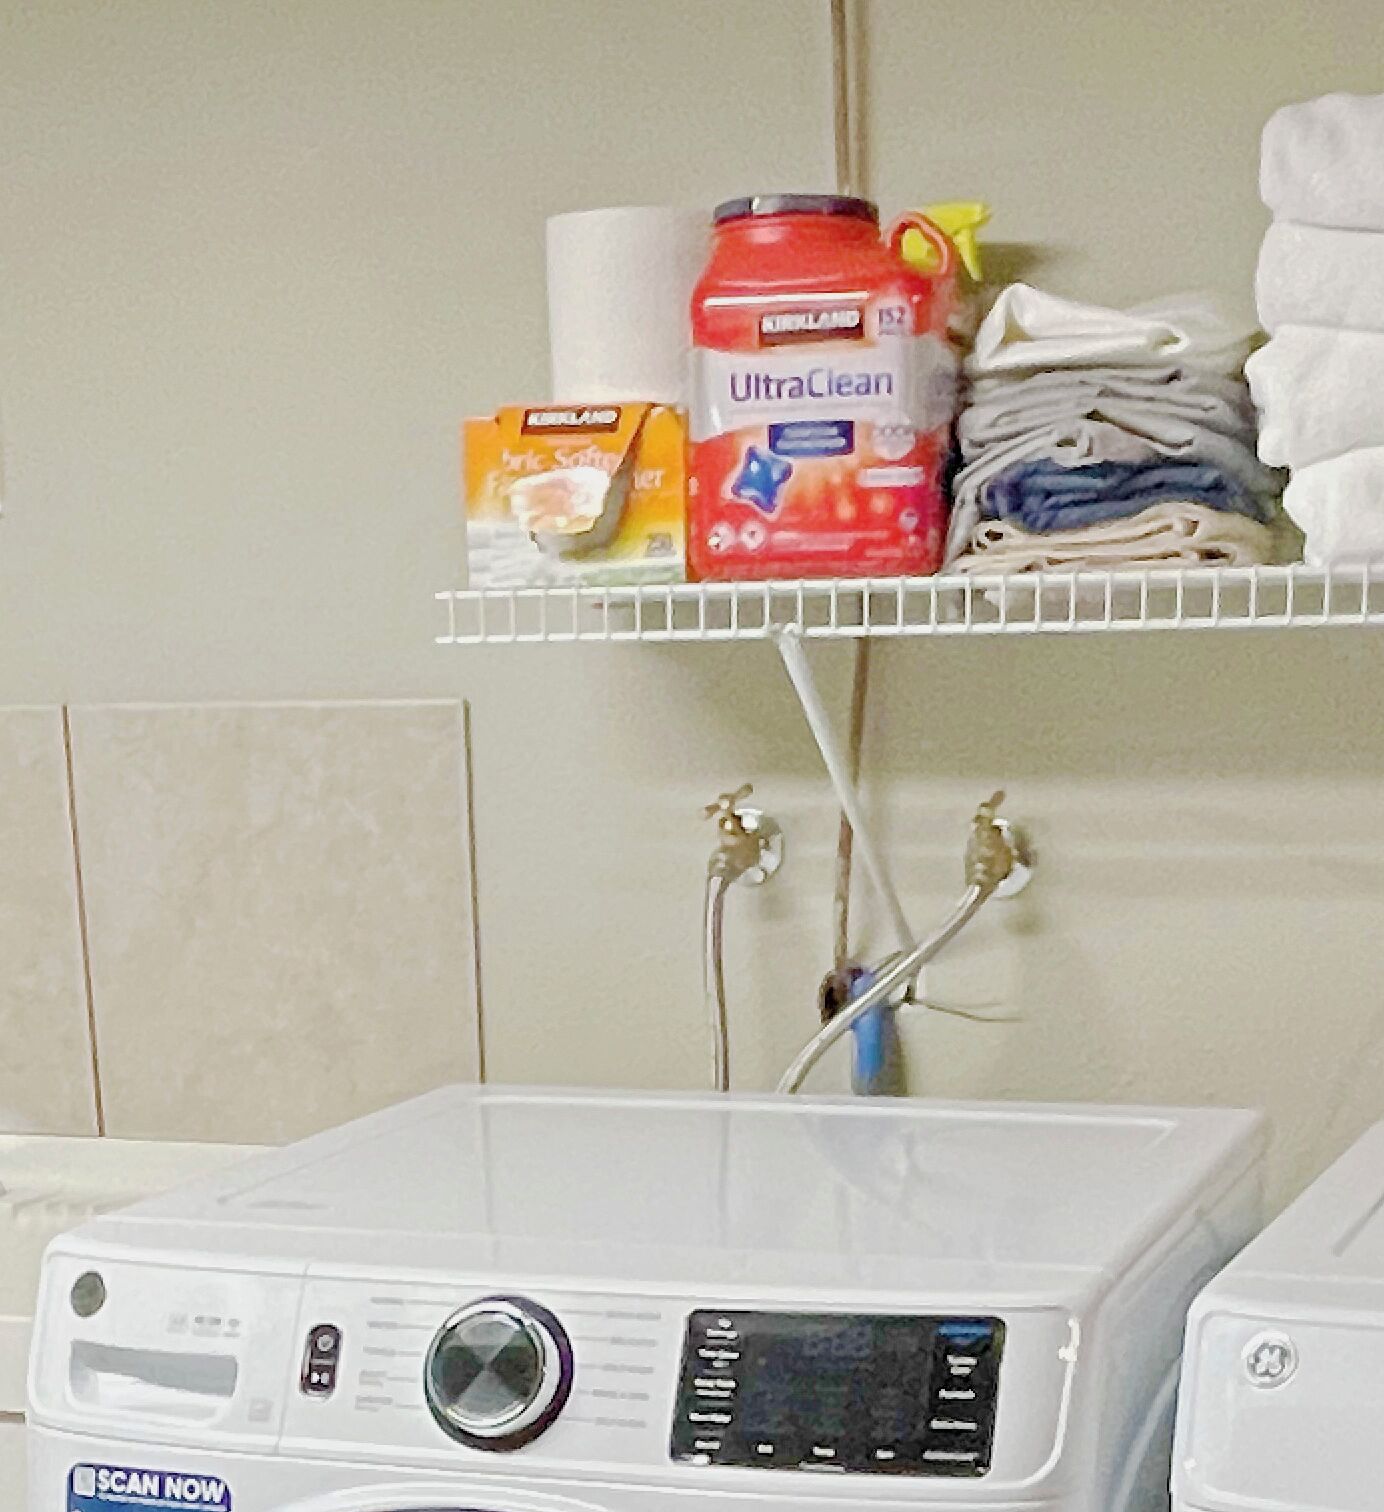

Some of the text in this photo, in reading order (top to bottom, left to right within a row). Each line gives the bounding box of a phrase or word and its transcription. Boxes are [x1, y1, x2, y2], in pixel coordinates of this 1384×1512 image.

[762, 311, 860, 334] KIRKLAND
[730, 366, 893, 402] UltraClean
[527, 410, 619, 426] KIRKLAND
[97, 1469, 160, 1499] SCAN
[165, 1476, 225, 1504] NOW
